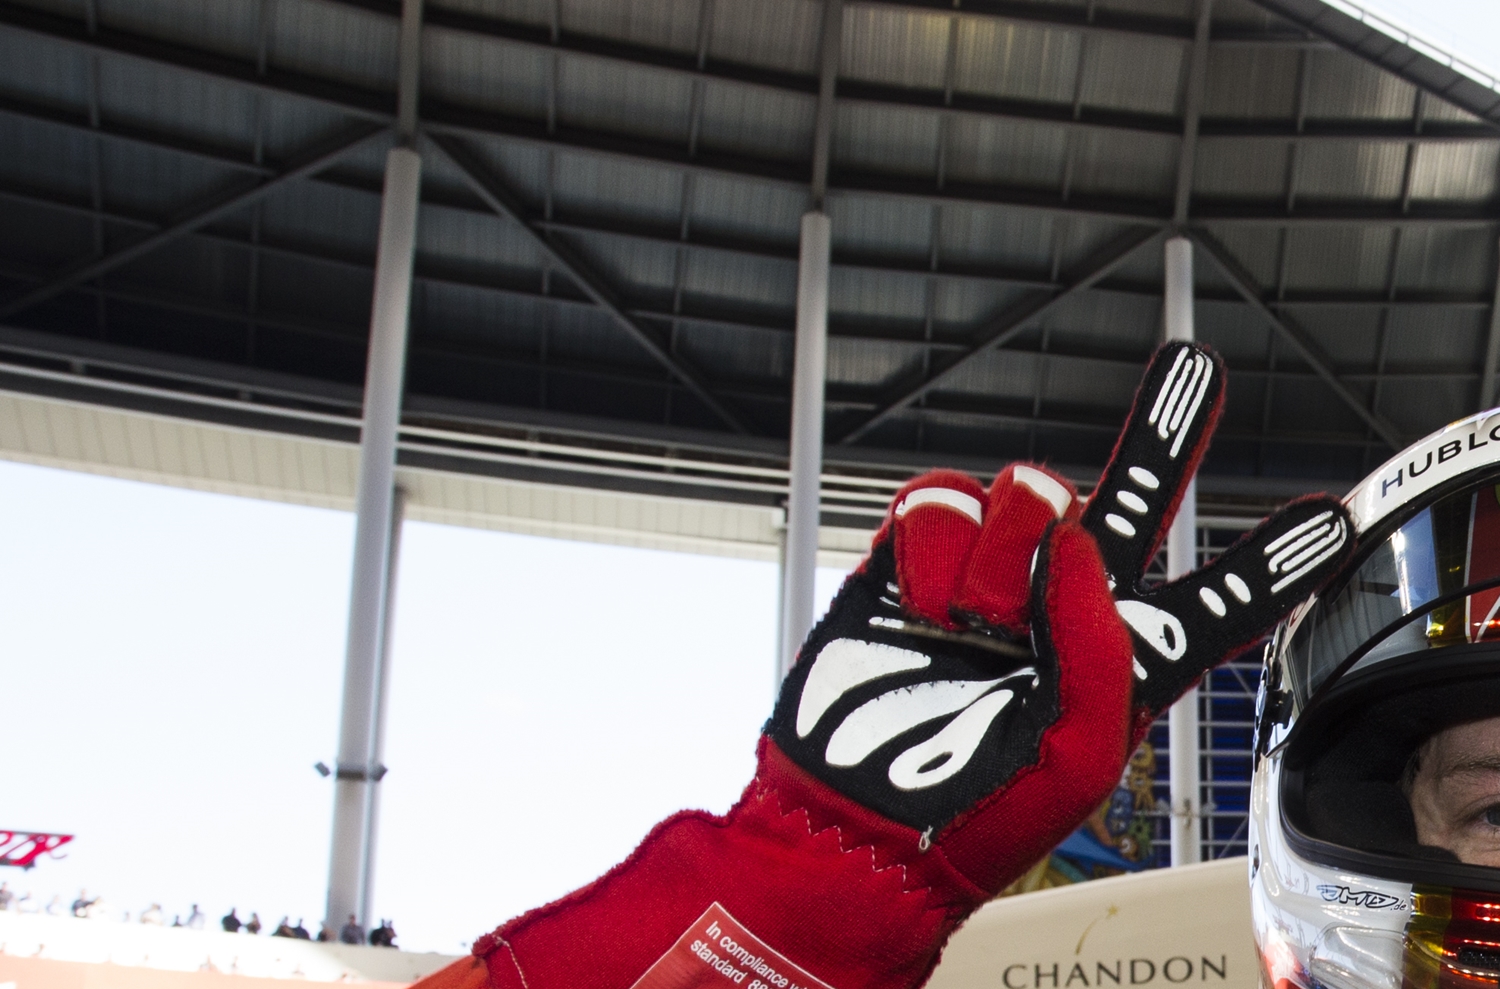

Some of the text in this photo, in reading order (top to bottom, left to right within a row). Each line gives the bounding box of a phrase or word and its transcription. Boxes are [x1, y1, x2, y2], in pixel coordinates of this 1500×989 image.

[690, 938, 748, 985] standard
[705, 920, 722, 940] In
[719, 932, 790, 989] compliance
